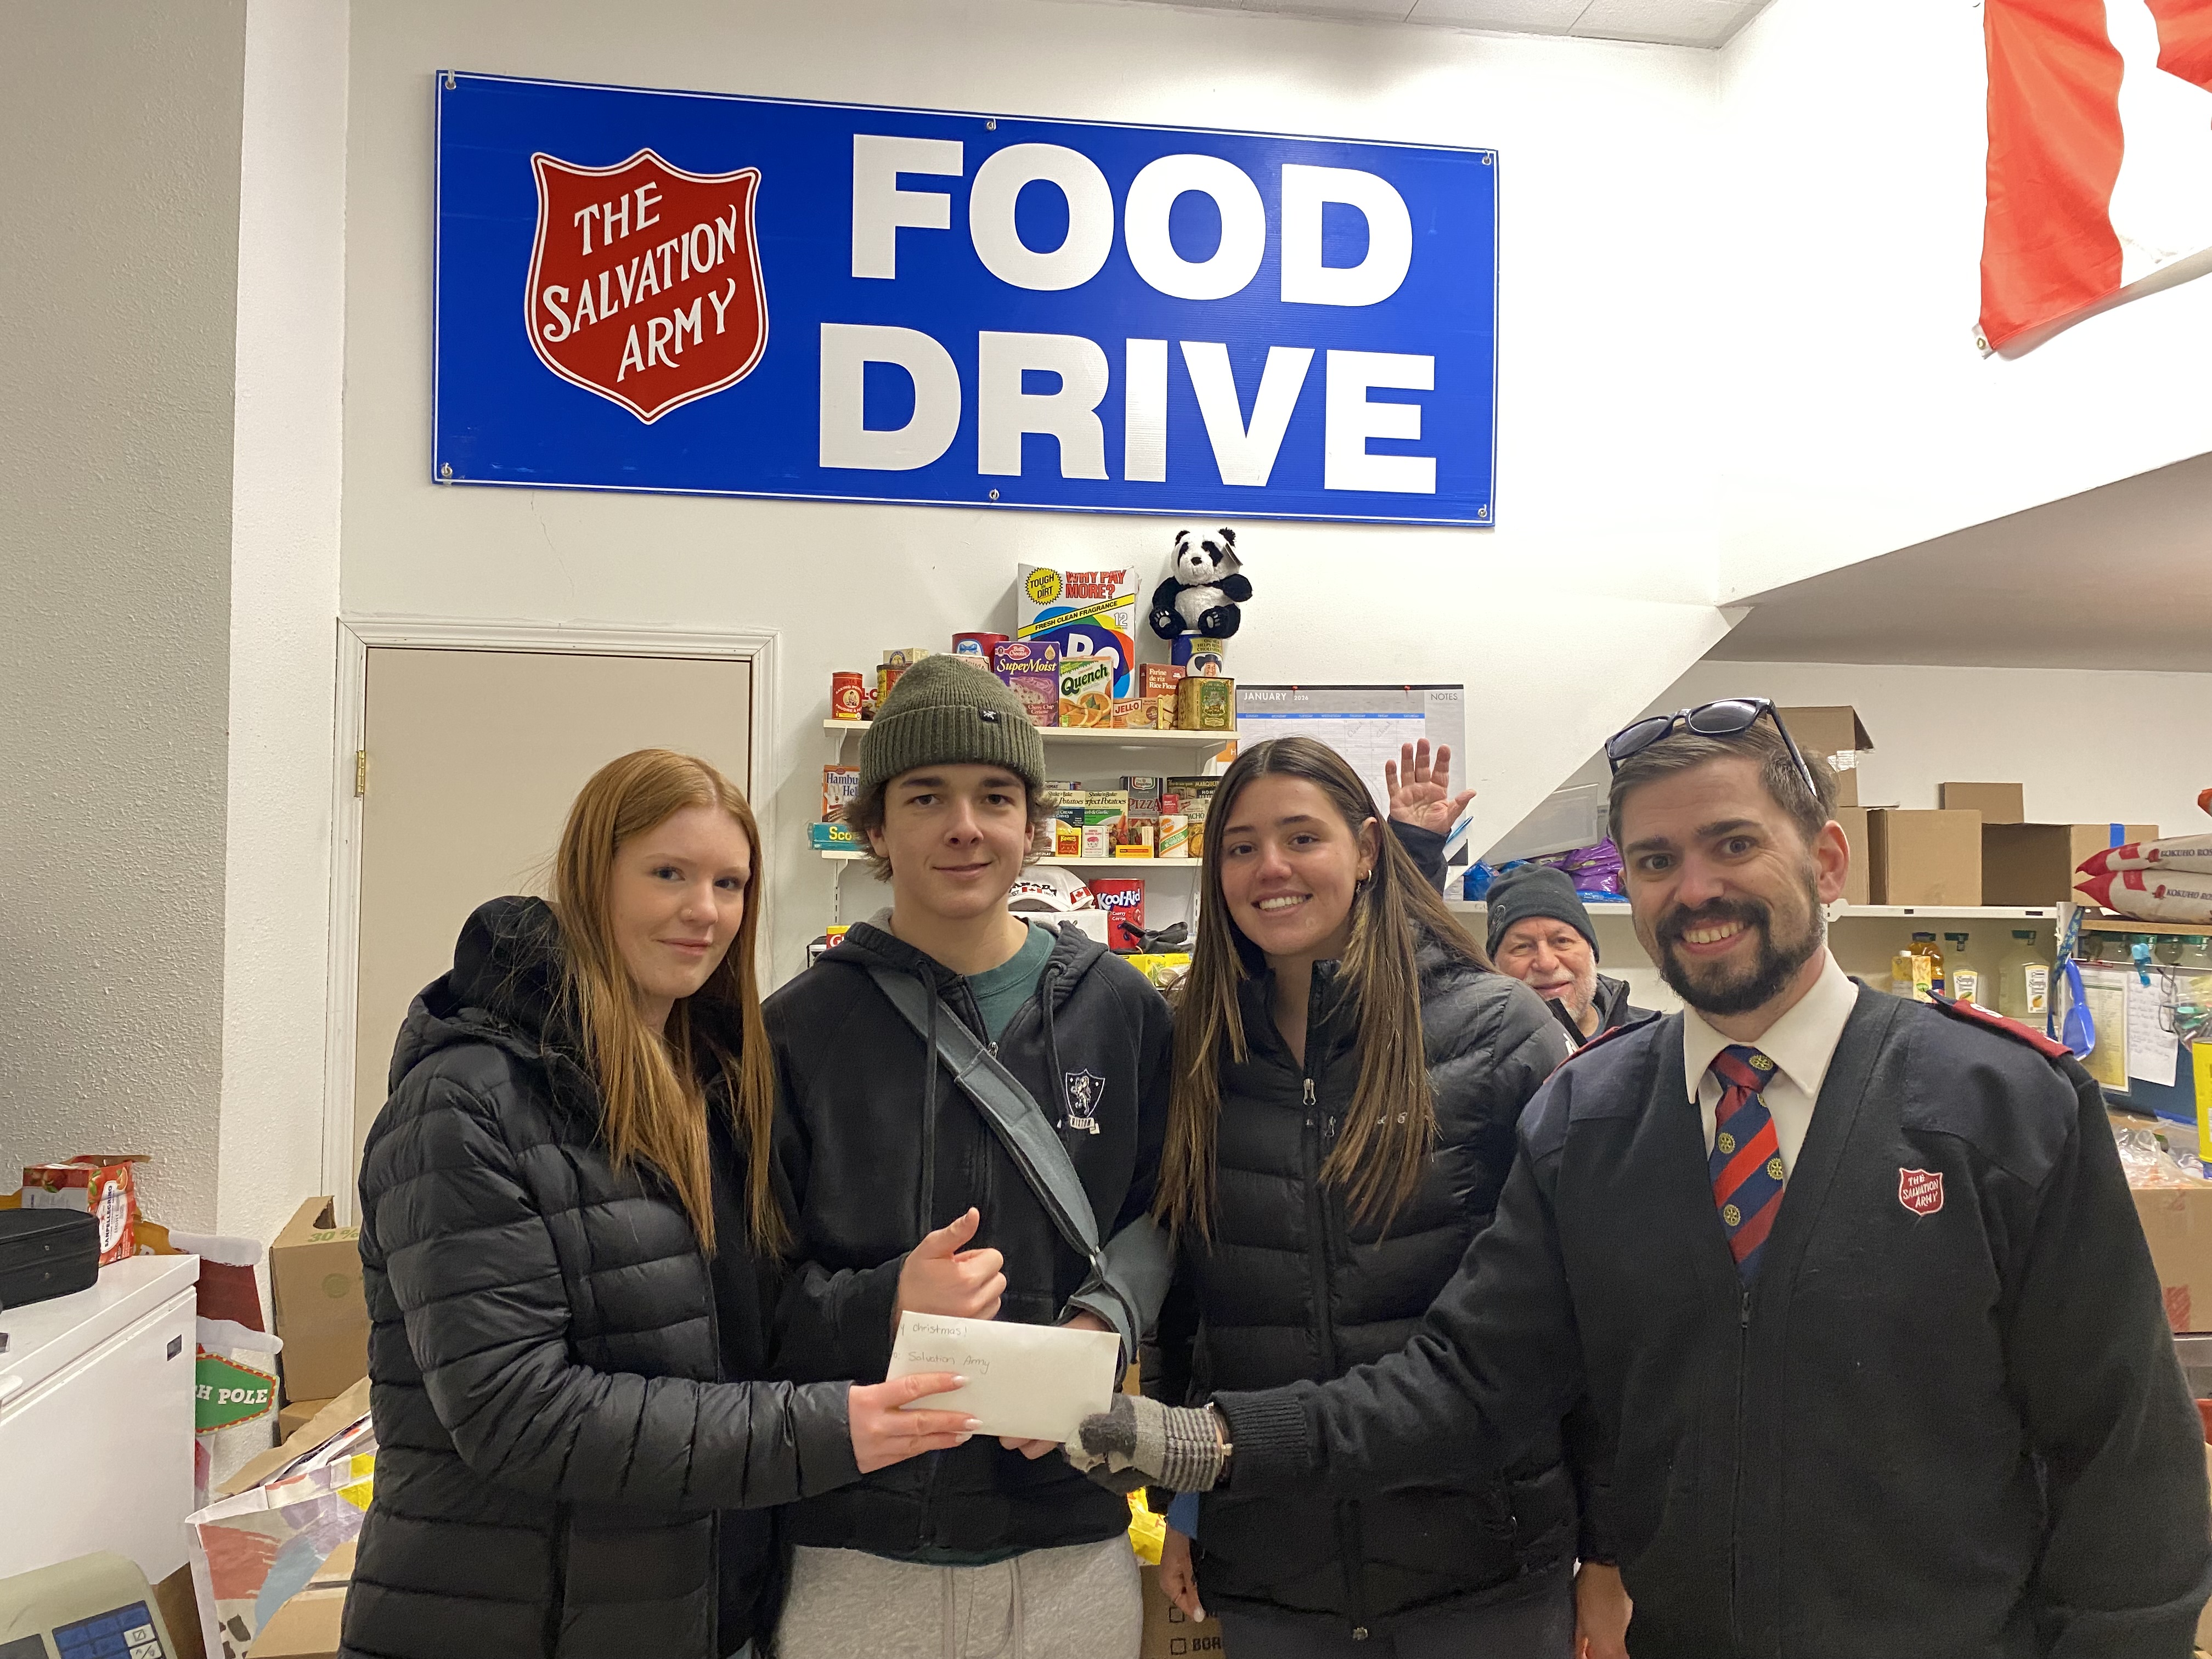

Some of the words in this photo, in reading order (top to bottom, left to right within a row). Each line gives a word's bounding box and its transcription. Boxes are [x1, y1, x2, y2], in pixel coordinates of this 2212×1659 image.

[574, 182, 663, 256] THE
[852, 134, 1413, 307] FOOD
[543, 204, 737, 342] SALVATION
[617, 278, 736, 383] ARMY
[820, 322, 1437, 495] DRIVE
[1030, 573, 1054, 589] TOUGH
[1065, 571, 1098, 584] WHY
[1100, 569, 1127, 584] PAY
[1037, 586, 1053, 599] DIRT
[1065, 584, 1115, 599] MORE?
[1035, 619, 1056, 631] FRESH
[1057, 612, 1078, 623] CLEAN
[1079, 601, 1118, 617] FRAGRANCE
[1114, 612, 1128, 627] 12
[1061, 664, 1108, 696] Quench
[1244, 692, 1286, 701] JANUARY
[826, 773, 858, 785] Hambu
[843, 785, 858, 795] Hel
[1085, 797, 1101, 806] erfect
[1128, 798, 1163, 811] PIZZA
[829, 826, 852, 841] Sco
[1097, 888, 1141, 910] Kool-Aid
[2167, 889, 2199, 899] KOKUHO
[1070, 1118, 1091, 1128] RIXTON
[1908, 1174, 1926, 1186] THE
[1903, 1178, 1939, 1200] SALVATION
[1915, 1191, 1938, 1207] ARMY
[308, 1231, 336, 1243] 30
[963, 1355, 990, 1374] Army
[218, 1388, 268, 1404] POLE
